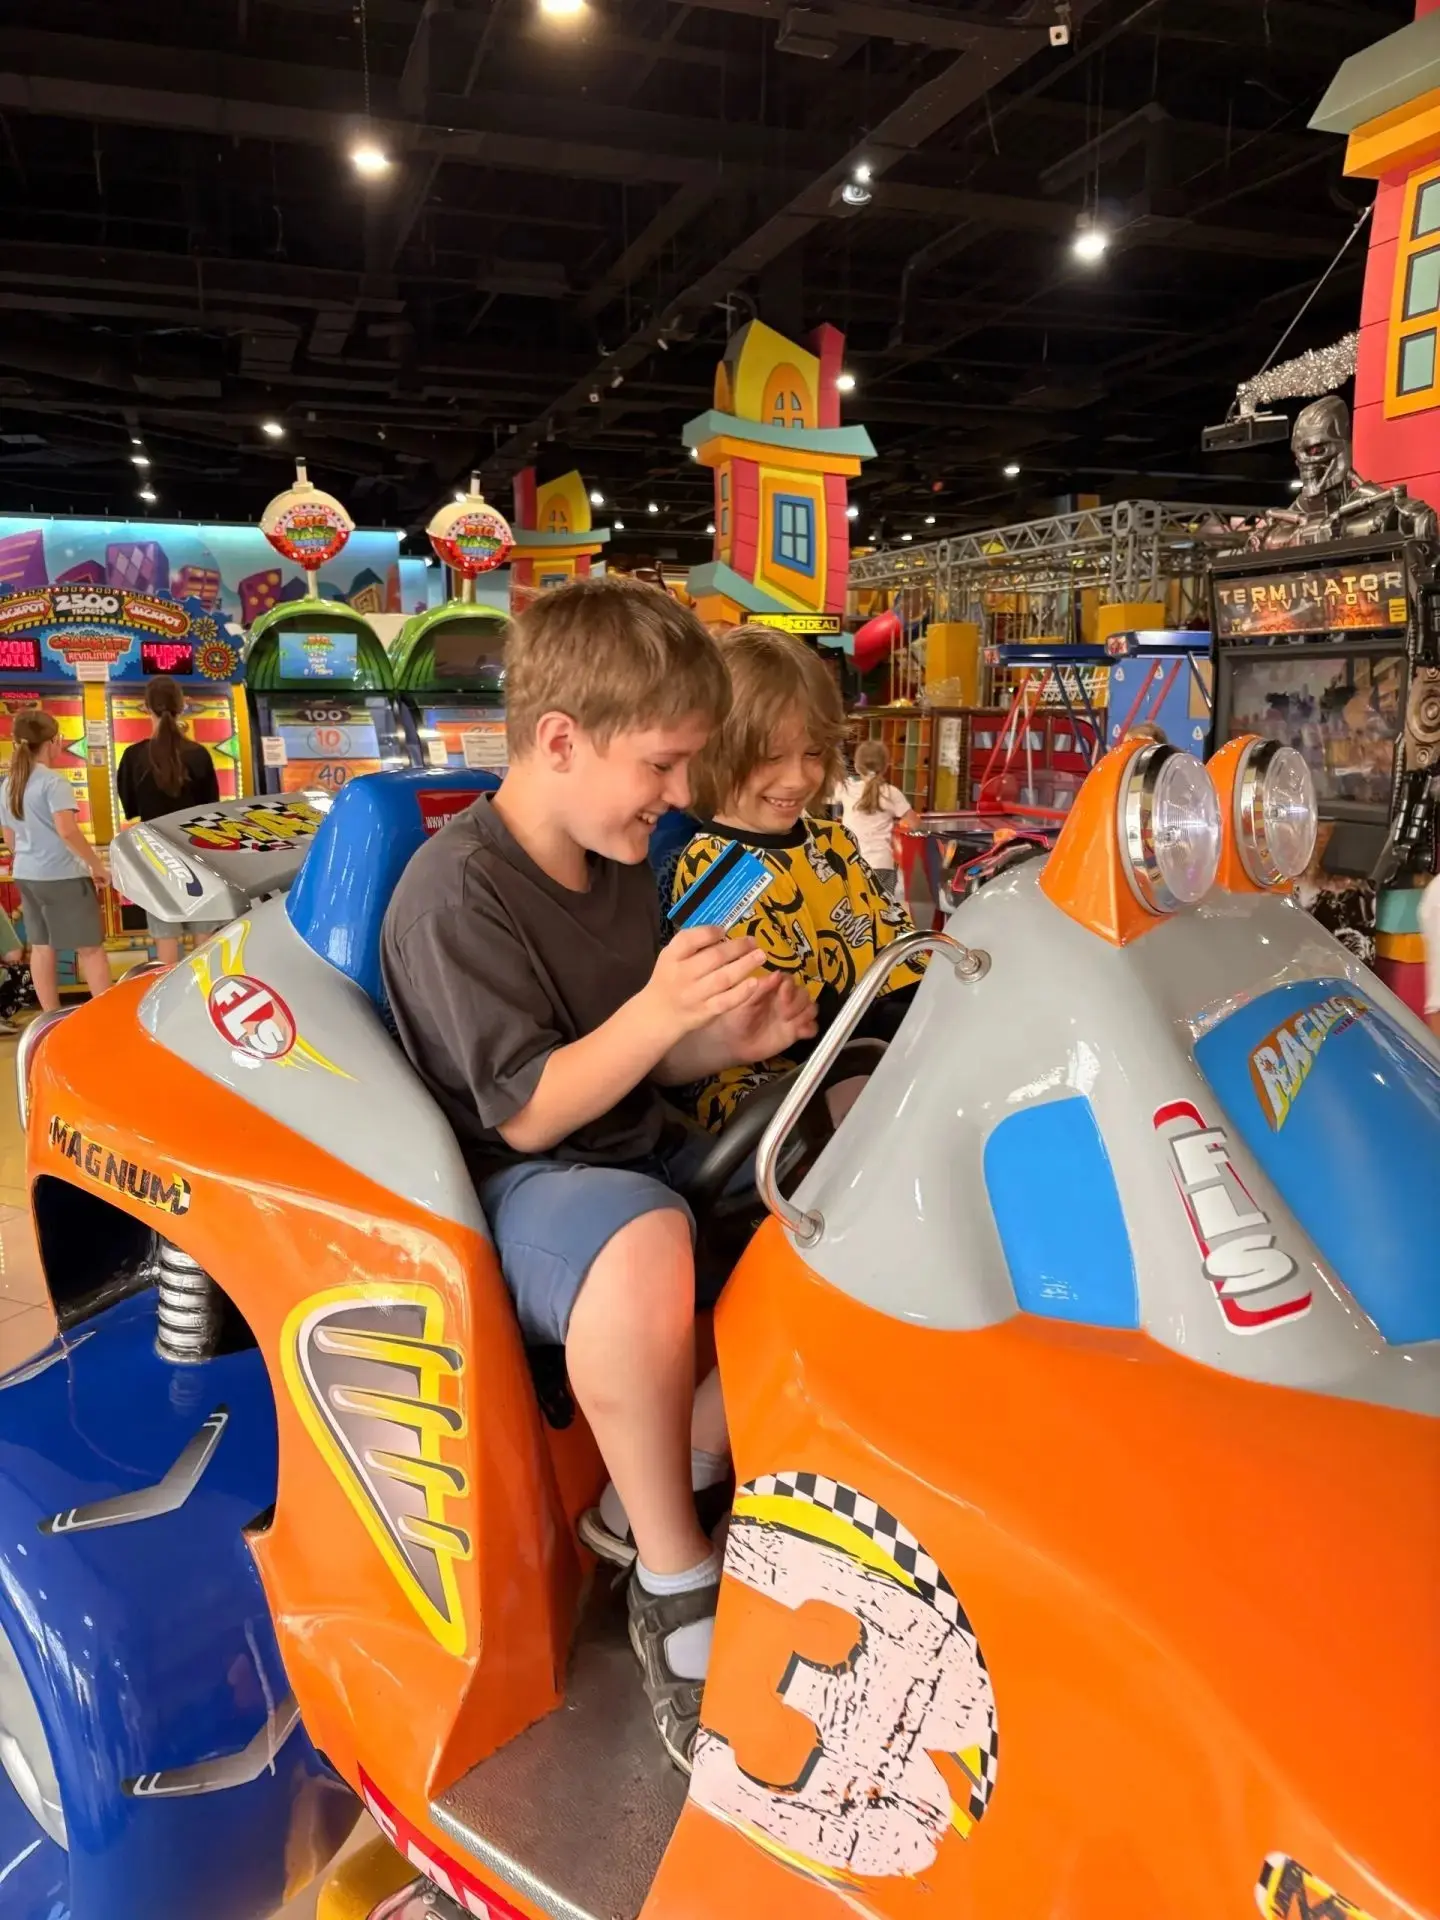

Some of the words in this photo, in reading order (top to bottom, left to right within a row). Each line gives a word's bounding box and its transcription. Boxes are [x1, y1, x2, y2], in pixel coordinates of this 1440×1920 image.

[293, 515, 327, 528] BIG
[464, 524, 495, 536] BIG
[1220, 571, 1403, 605] TERMINATOR
[55, 593, 119, 614] 2500
[1235, 590, 1380, 614] SALVATION
[130, 604, 181, 627] JACKPOT
[790, 619, 806, 630] NO
[807, 619, 837, 630] DEAL
[143, 644, 192, 658] HURRY
[156, 657, 177, 669] UP
[305, 709, 342, 721] 100
[315, 726, 341, 747] 10
[318, 764, 346, 786] 40
[1252, 996, 1348, 1120] RACING
[51, 1116, 184, 1214] MAGNUM
